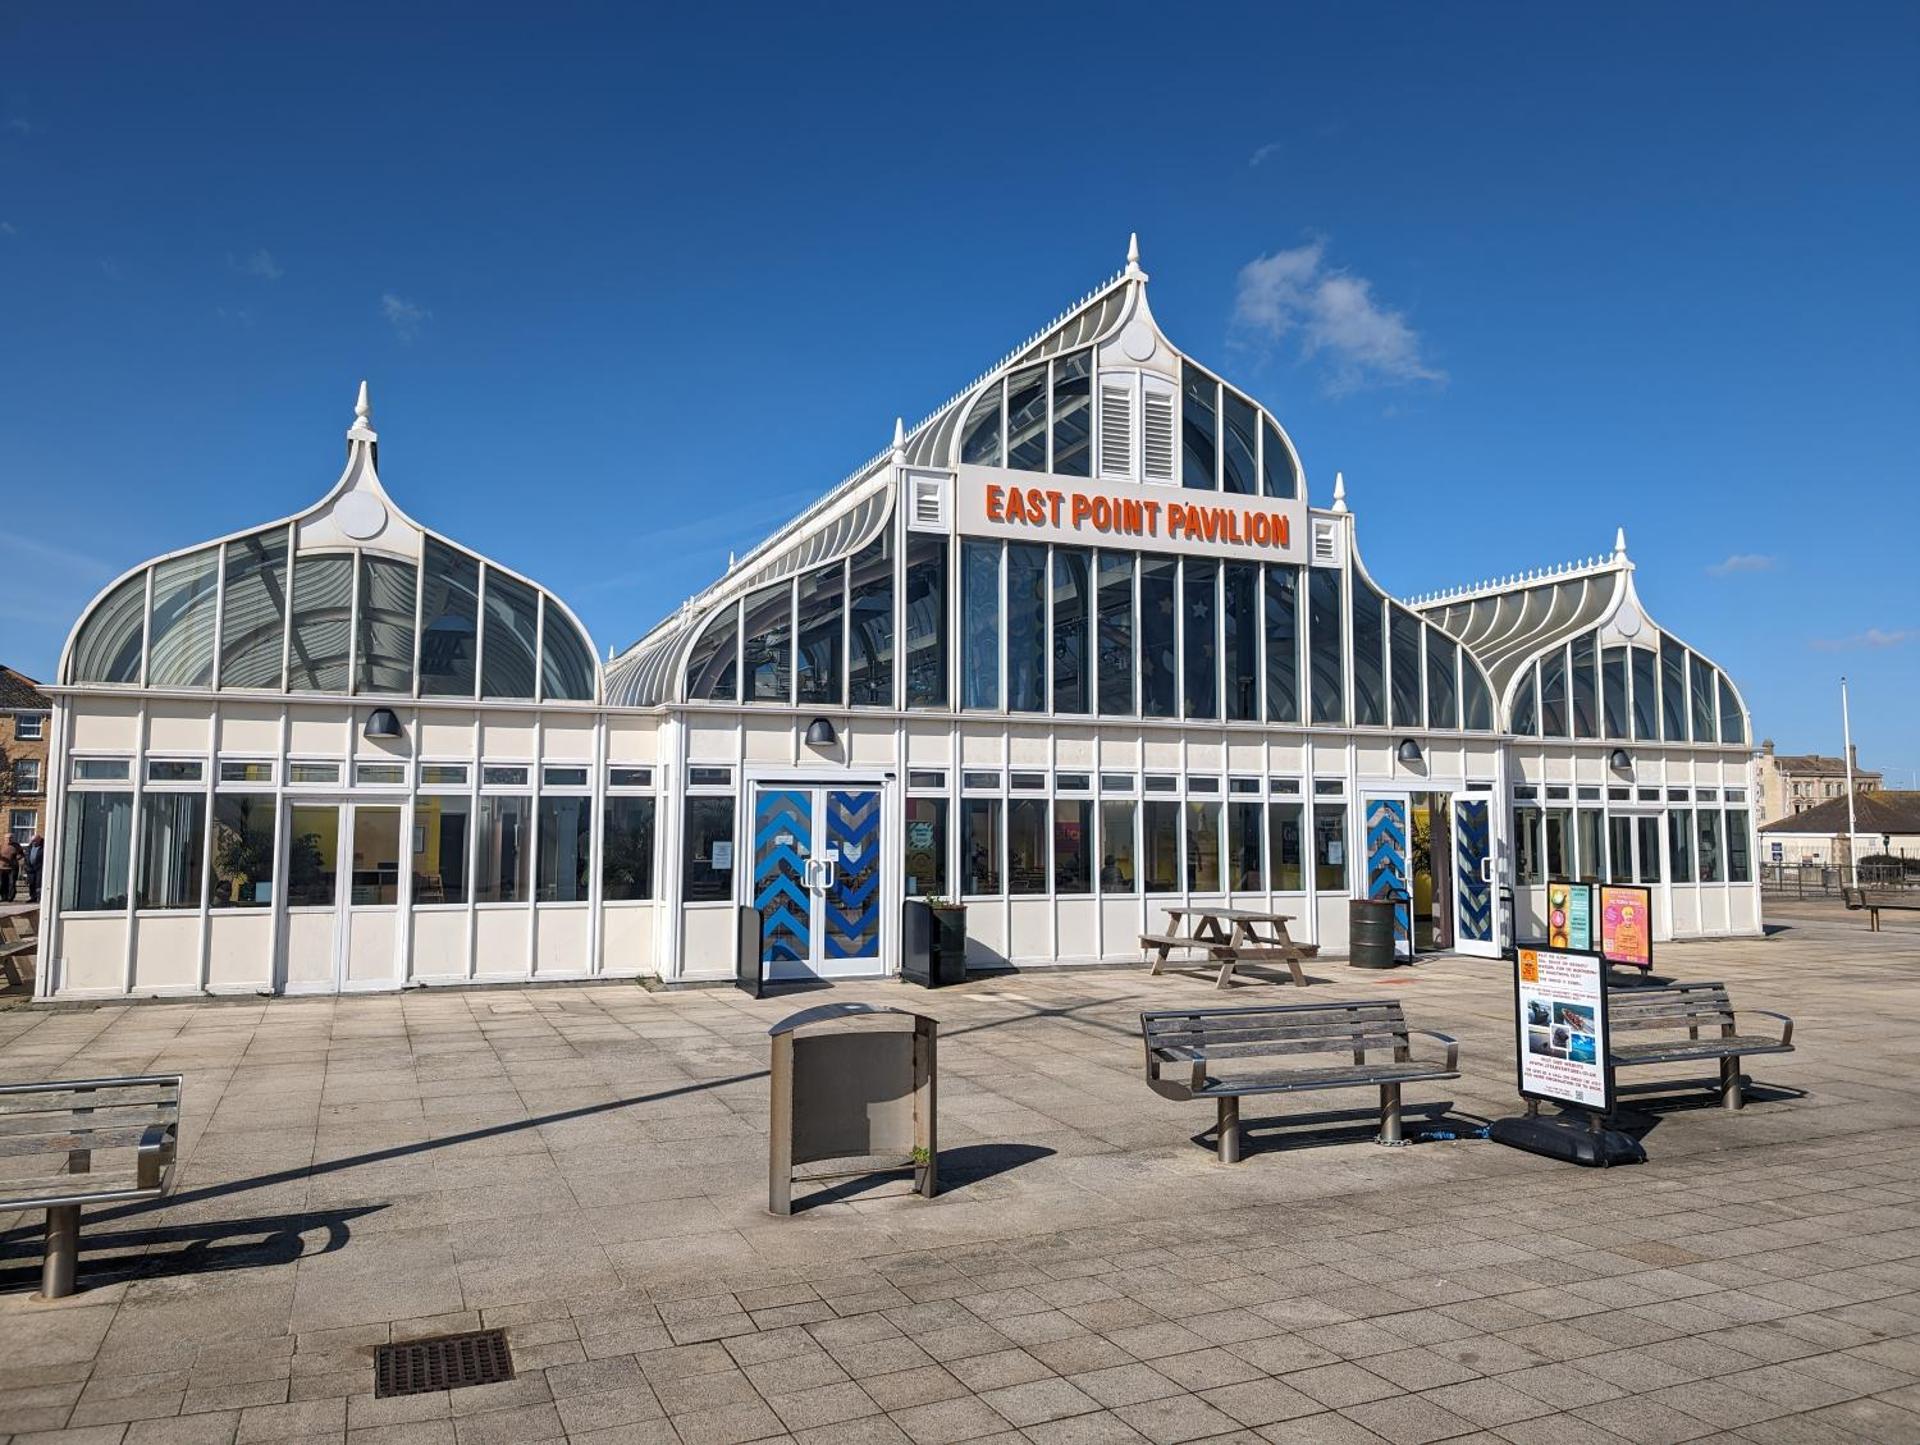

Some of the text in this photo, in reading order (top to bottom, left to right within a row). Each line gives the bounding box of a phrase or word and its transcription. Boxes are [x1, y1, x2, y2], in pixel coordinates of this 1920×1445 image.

[986, 484, 1289, 548] EAST POINT PAVILION
